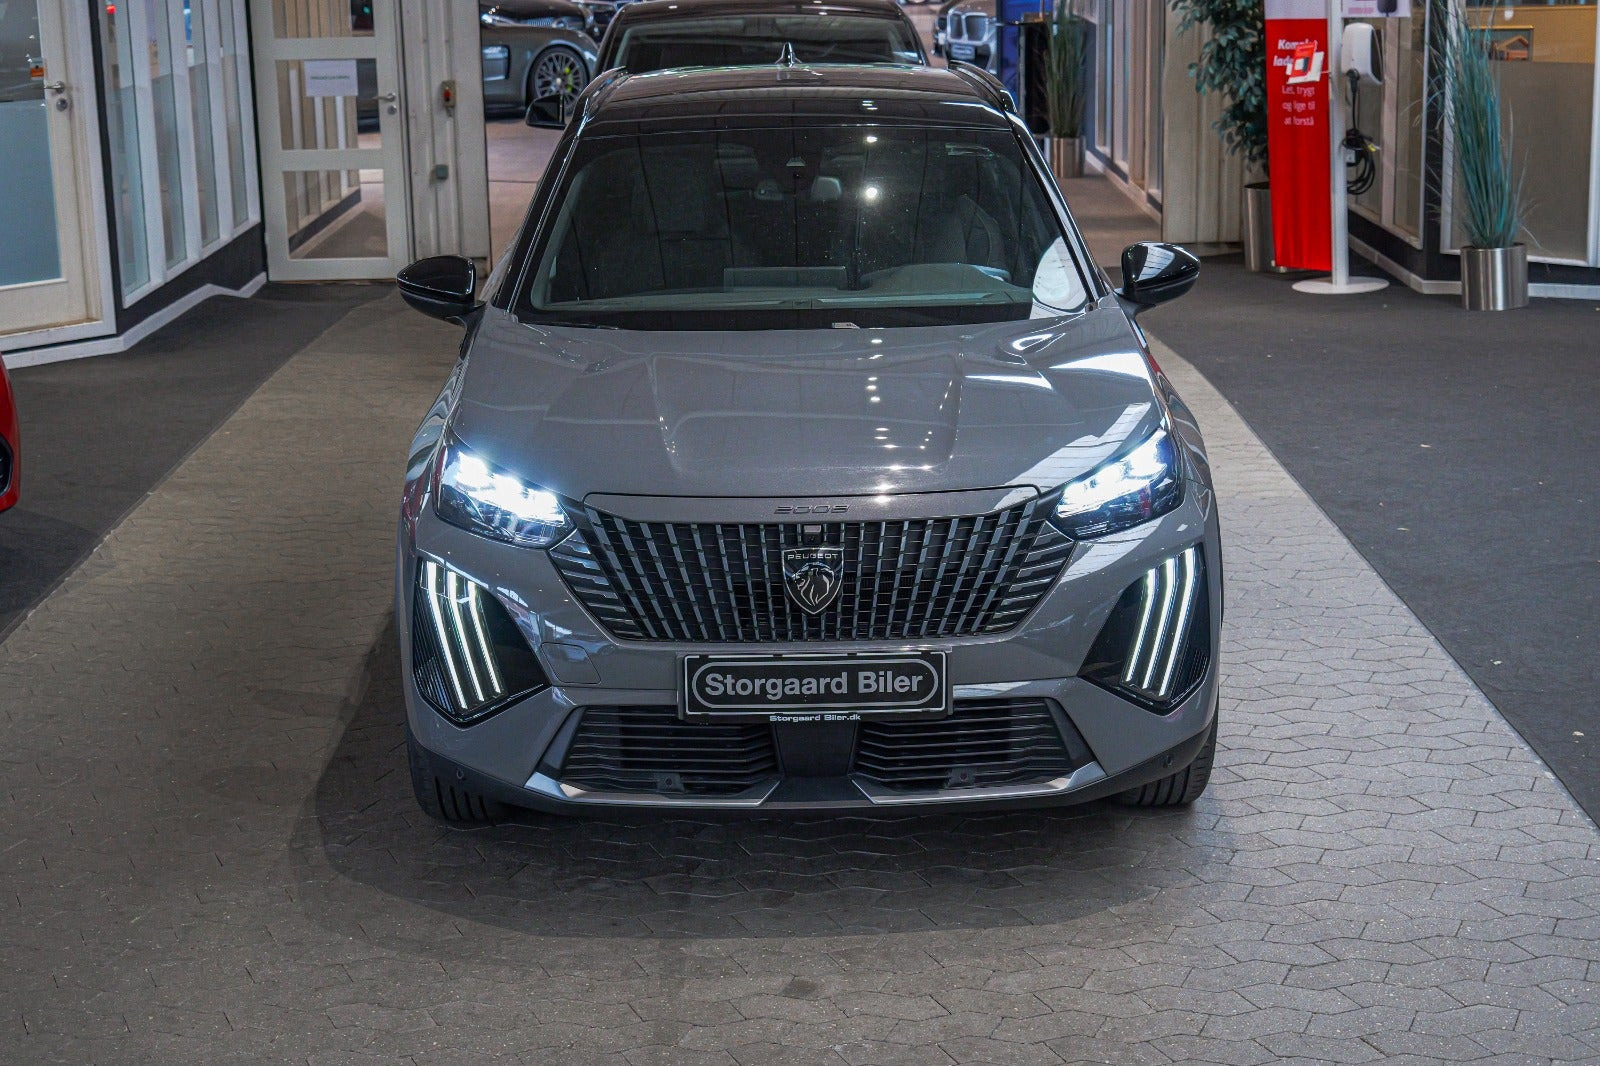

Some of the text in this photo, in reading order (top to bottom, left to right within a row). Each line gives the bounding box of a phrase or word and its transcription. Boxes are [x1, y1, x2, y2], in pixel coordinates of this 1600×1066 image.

[1297, 86, 1315, 97] trygt
[1282, 101, 1316, 112] og lige til
[1284, 116, 1315, 126] at forstå
[705, 670, 923, 700] Storgaard Biler
[769, 713, 861, 722] Storgaard Biler.dk
